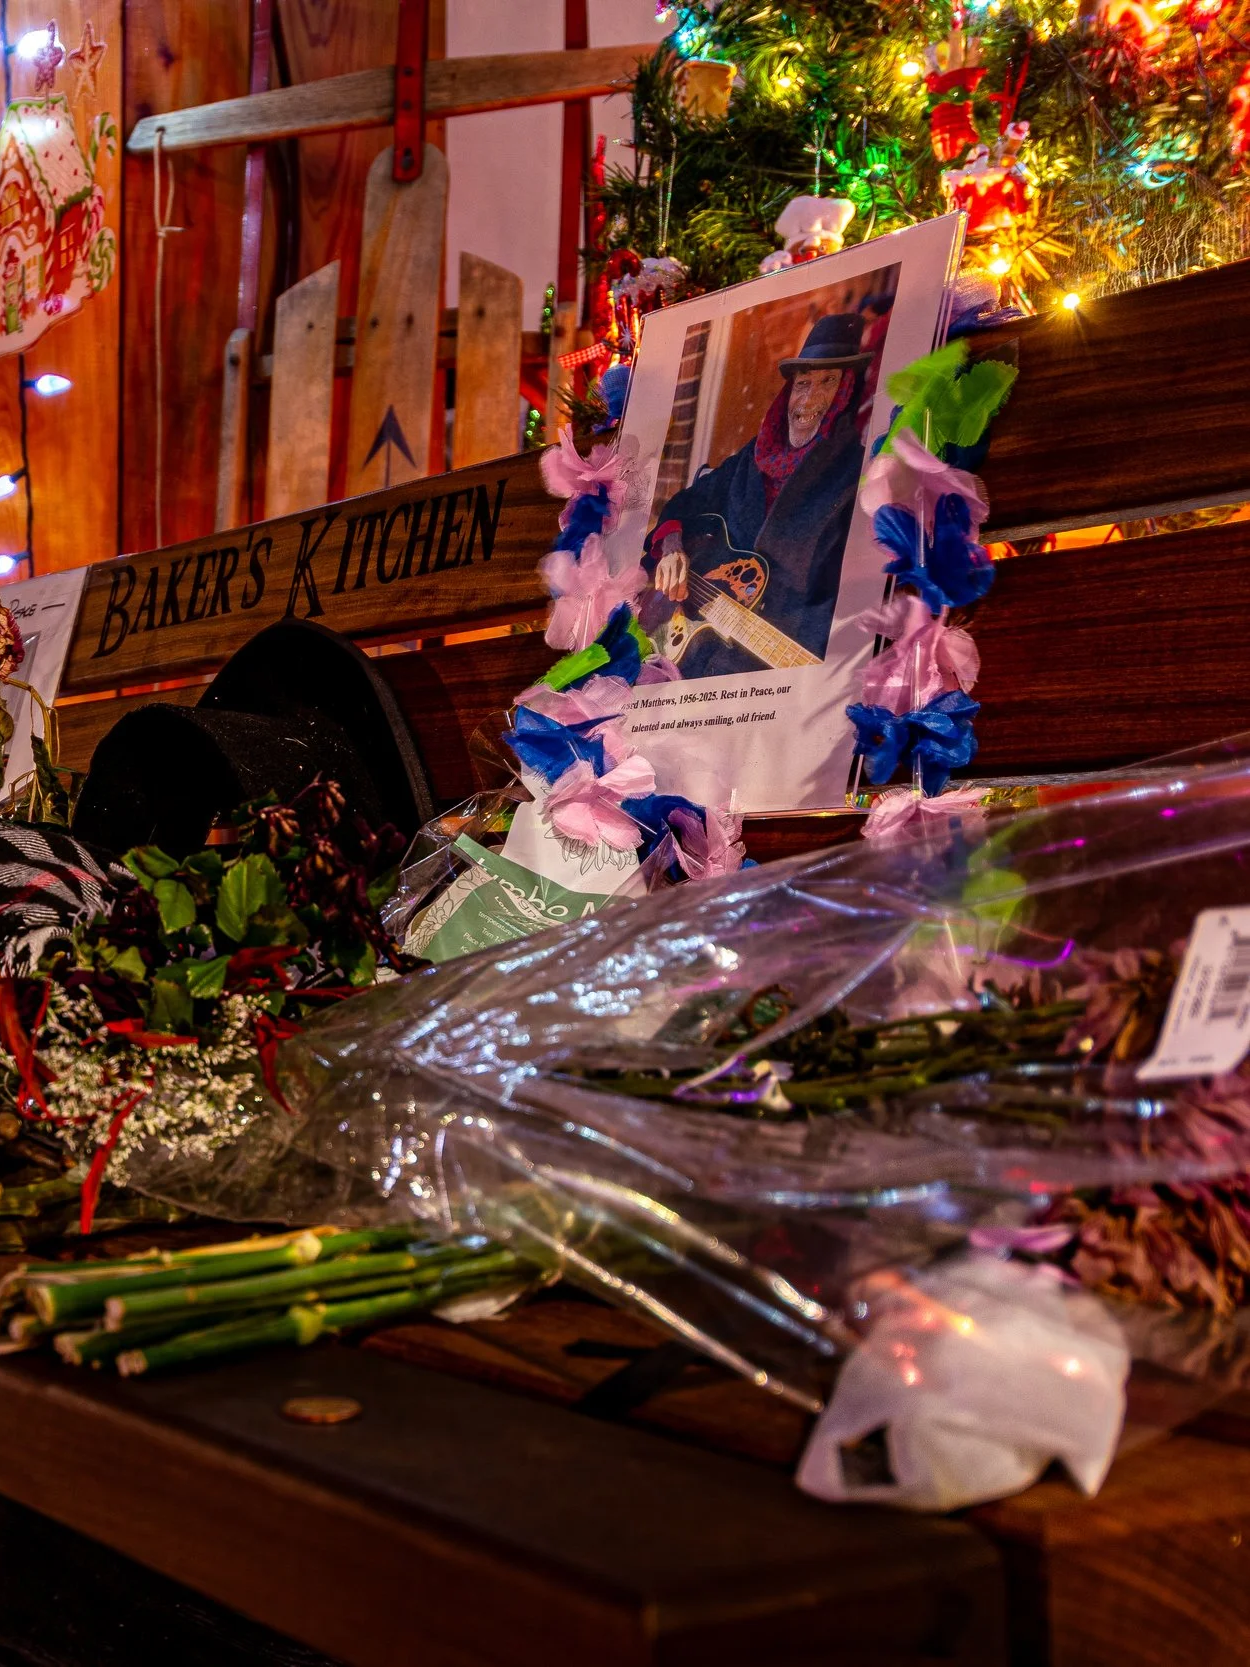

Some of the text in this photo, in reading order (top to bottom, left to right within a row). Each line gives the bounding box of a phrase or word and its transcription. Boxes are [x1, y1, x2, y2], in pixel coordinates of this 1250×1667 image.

[91, 478, 508, 659] BAKER'S KITCHEN
[639, 697, 677, 709] Matthews,
[678, 690, 719, 705] 1956-2025.
[720, 689, 739, 701] Rest
[739, 688, 748, 698] in
[750, 686, 775, 697] Peace,
[776, 685, 792, 694] our
[631, 710, 777, 733] talented and always smiling, old friend.
[463, 932, 479, 946] Place
